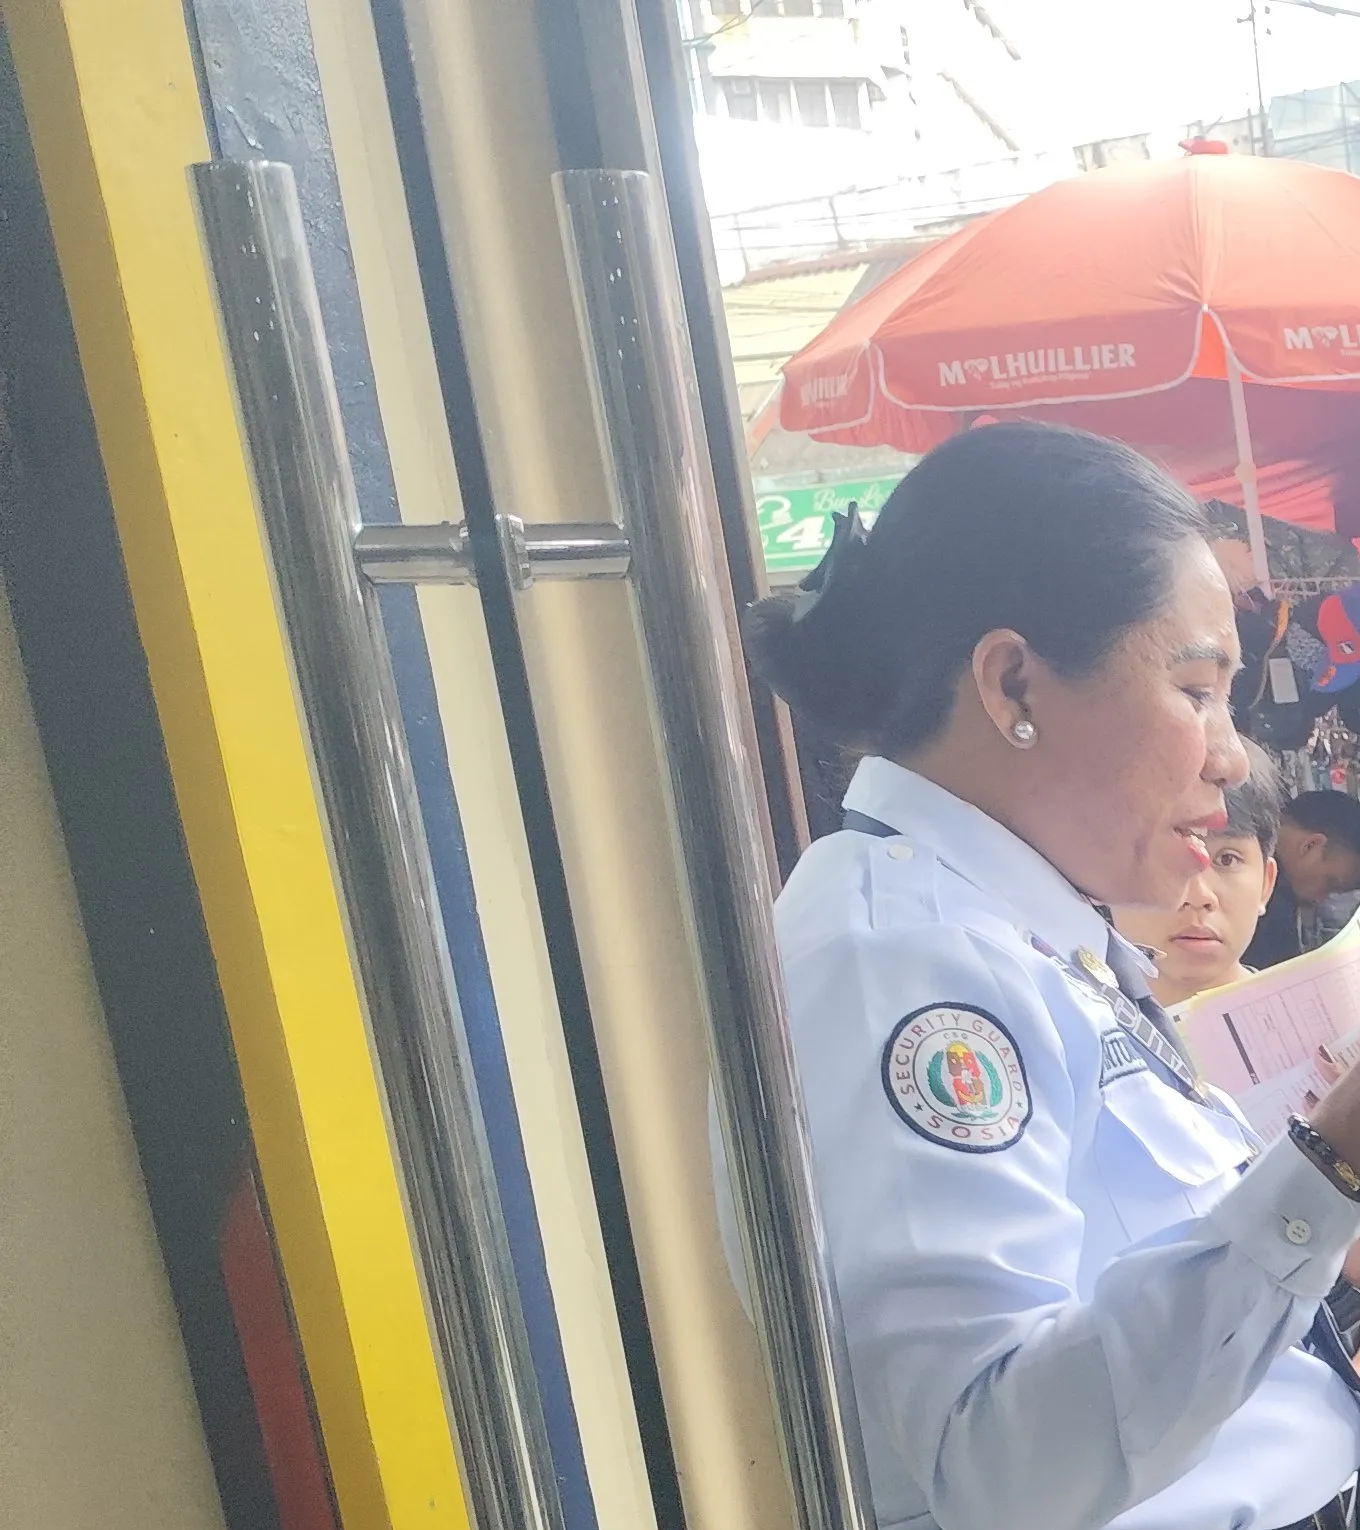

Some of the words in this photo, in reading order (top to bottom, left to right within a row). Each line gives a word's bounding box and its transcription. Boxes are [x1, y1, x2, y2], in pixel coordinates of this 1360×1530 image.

[896, 1013, 960, 1095] SECURITY
[972, 1020, 1023, 1091] GUARD
[928, 1115, 1019, 1141] SOSIA
